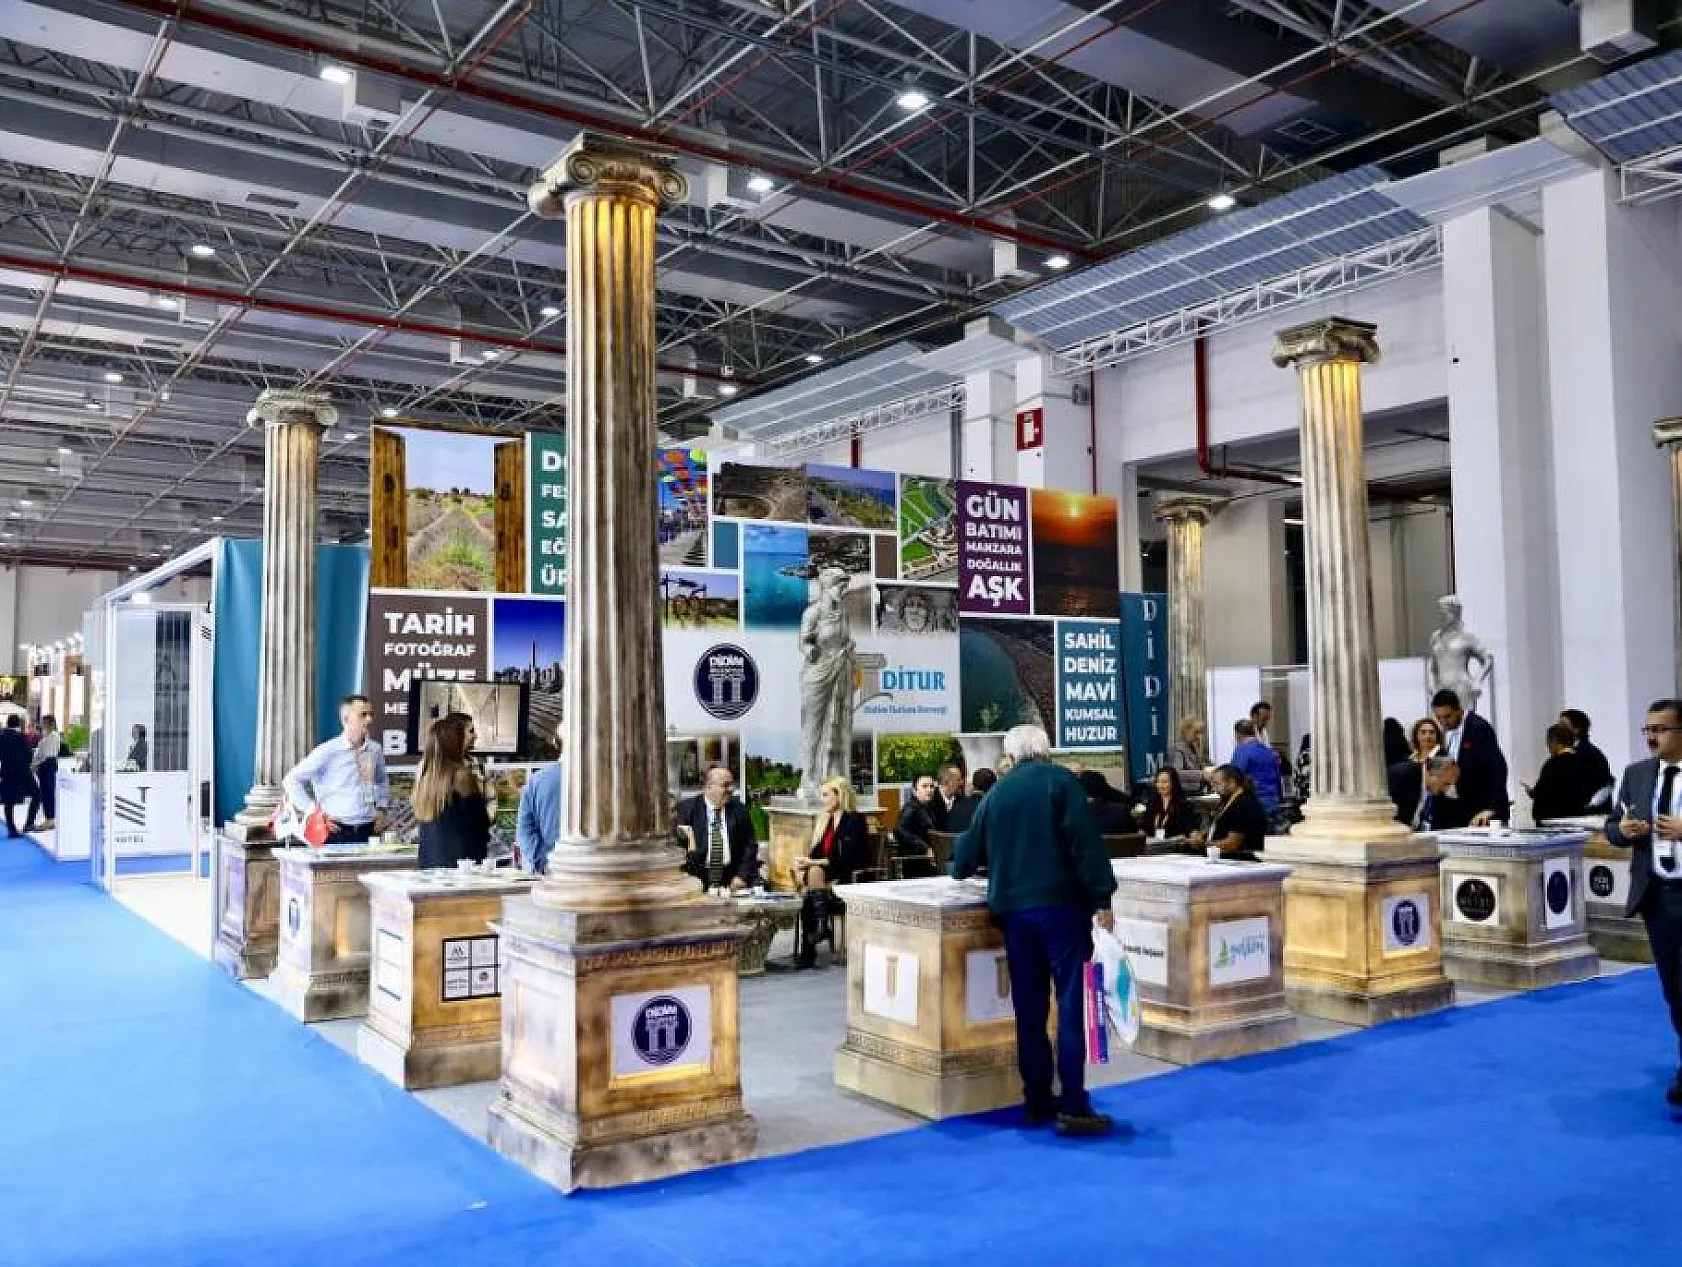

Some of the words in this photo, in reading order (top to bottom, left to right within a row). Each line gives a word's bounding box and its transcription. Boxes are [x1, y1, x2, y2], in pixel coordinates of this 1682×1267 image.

[965, 489, 1020, 521] GÜN
[965, 522, 1022, 541] BATIMI
[965, 540, 1023, 555] MANZARA
[966, 573, 1024, 607] AŞK
[383, 605, 475, 636] TARİH
[383, 639, 477, 657] FOTOĞRAF
[1064, 627, 1116, 650] SAHİL
[1064, 651, 1117, 674] DENİZ
[882, 664, 946, 692] DİTUR
[1065, 675, 1117, 703] MAVİ
[1064, 708, 1118, 722] KUMSAL
[1064, 725, 1118, 742] HUZUR
